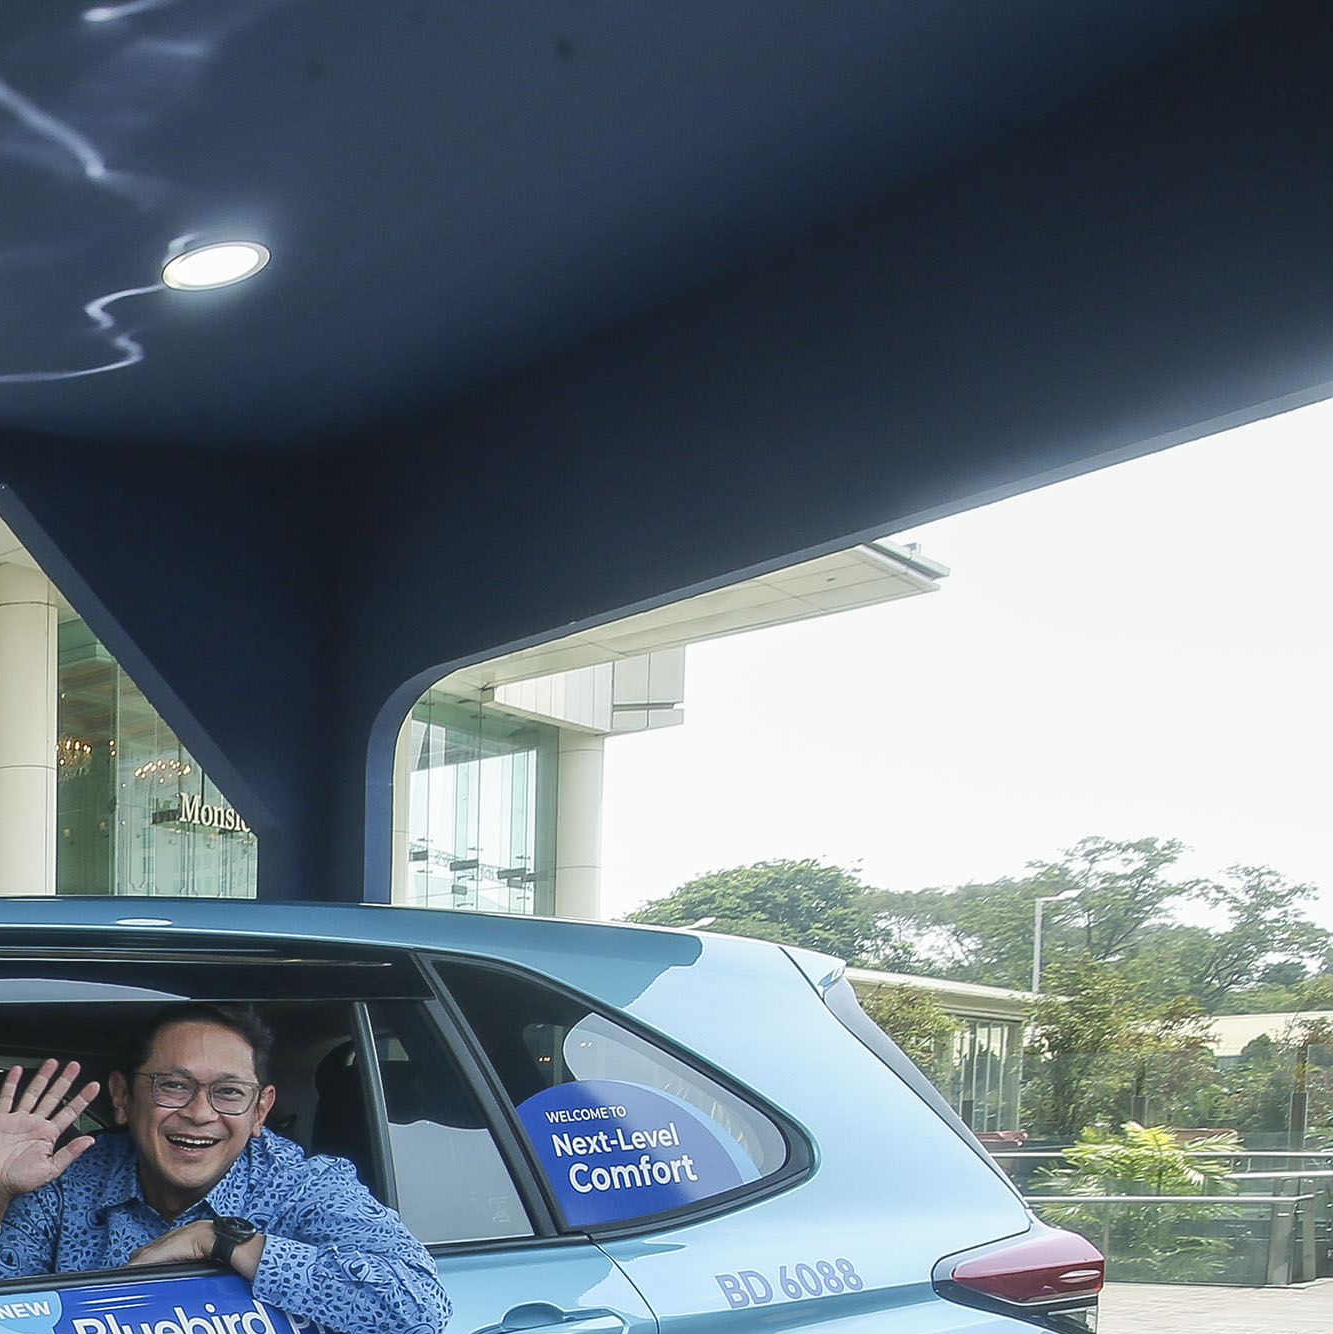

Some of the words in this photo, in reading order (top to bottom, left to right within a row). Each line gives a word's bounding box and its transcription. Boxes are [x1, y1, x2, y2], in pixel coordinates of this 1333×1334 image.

[545, 1105, 608, 1125] WELCOME
[608, 1104, 628, 1120] TO
[551, 1121, 681, 1158] Next-Level
[568, 1154, 699, 1194] Comfort
[714, 1269, 774, 1310] BD
[779, 1257, 865, 1301] 6088
